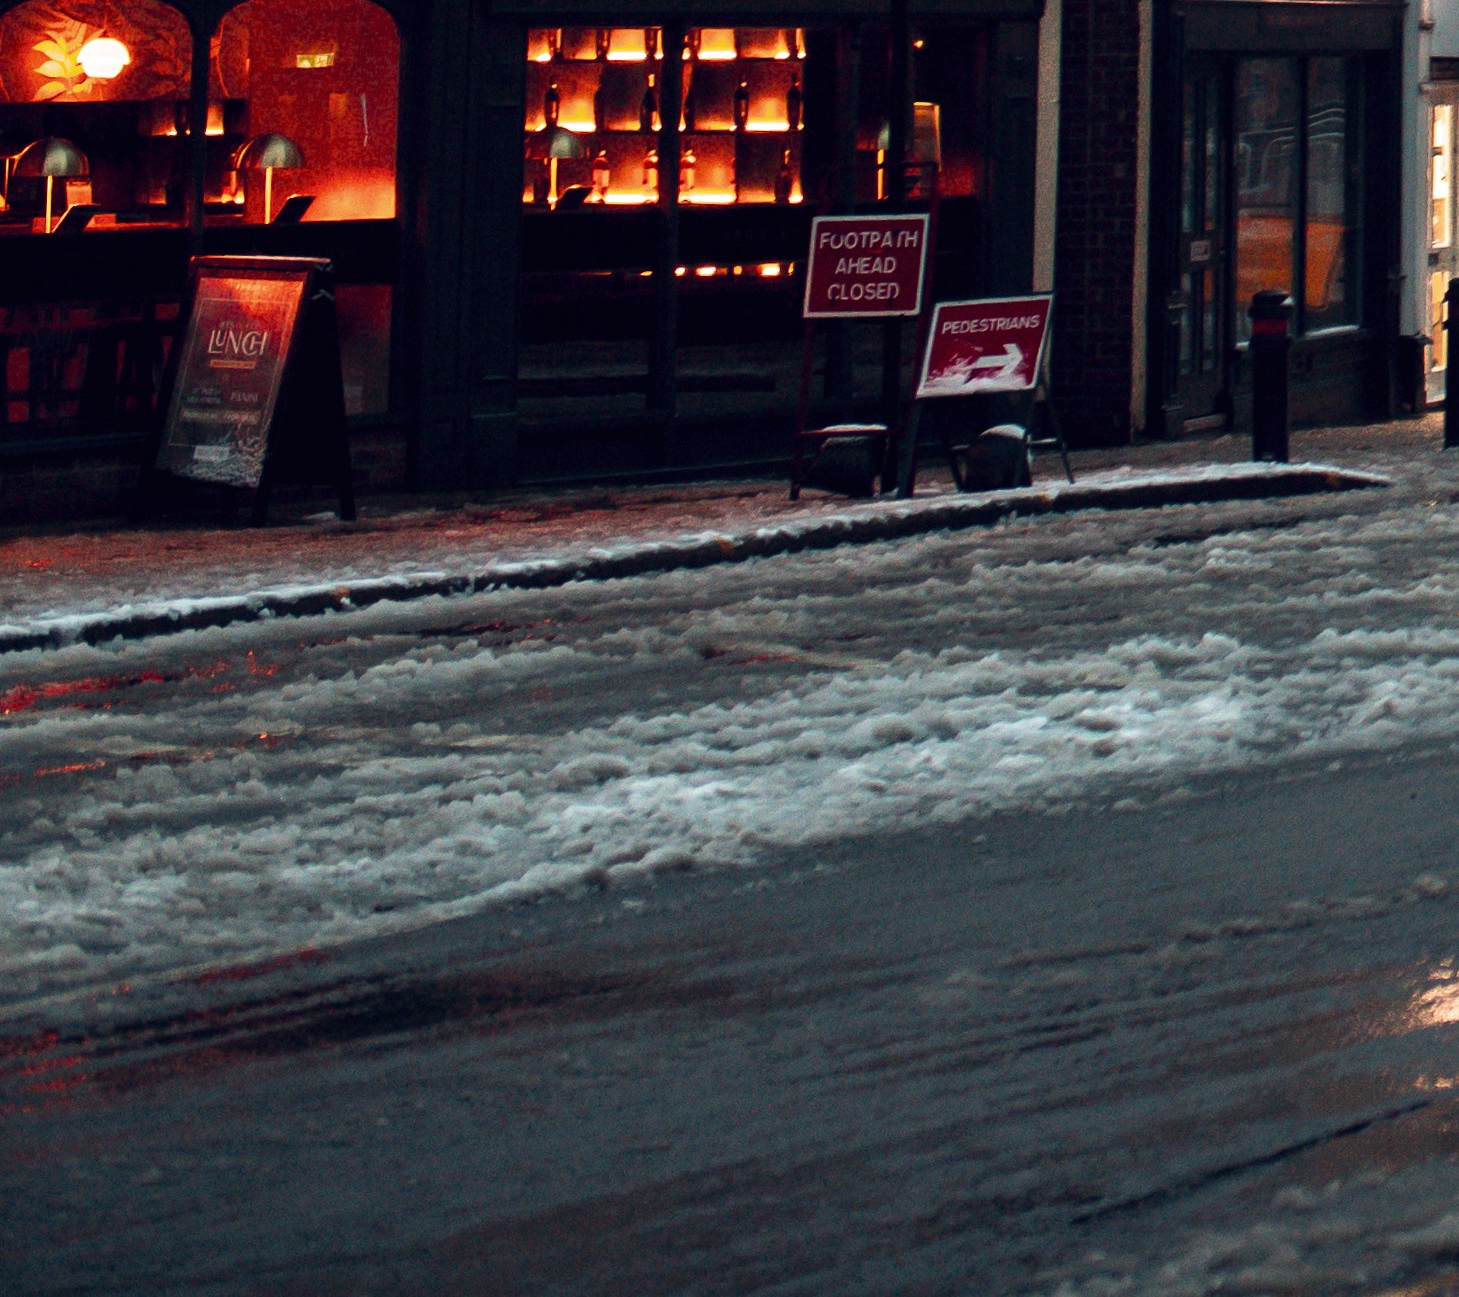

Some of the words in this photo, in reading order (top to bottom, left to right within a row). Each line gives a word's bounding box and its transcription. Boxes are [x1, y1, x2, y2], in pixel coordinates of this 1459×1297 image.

[819, 230, 919, 249] FOOTPATH
[835, 256, 898, 274] AHEAD
[827, 281, 900, 300] CLOSED
[941, 314, 1041, 335] PEDESTRIANS
[207, 329, 269, 356] LUNCH
